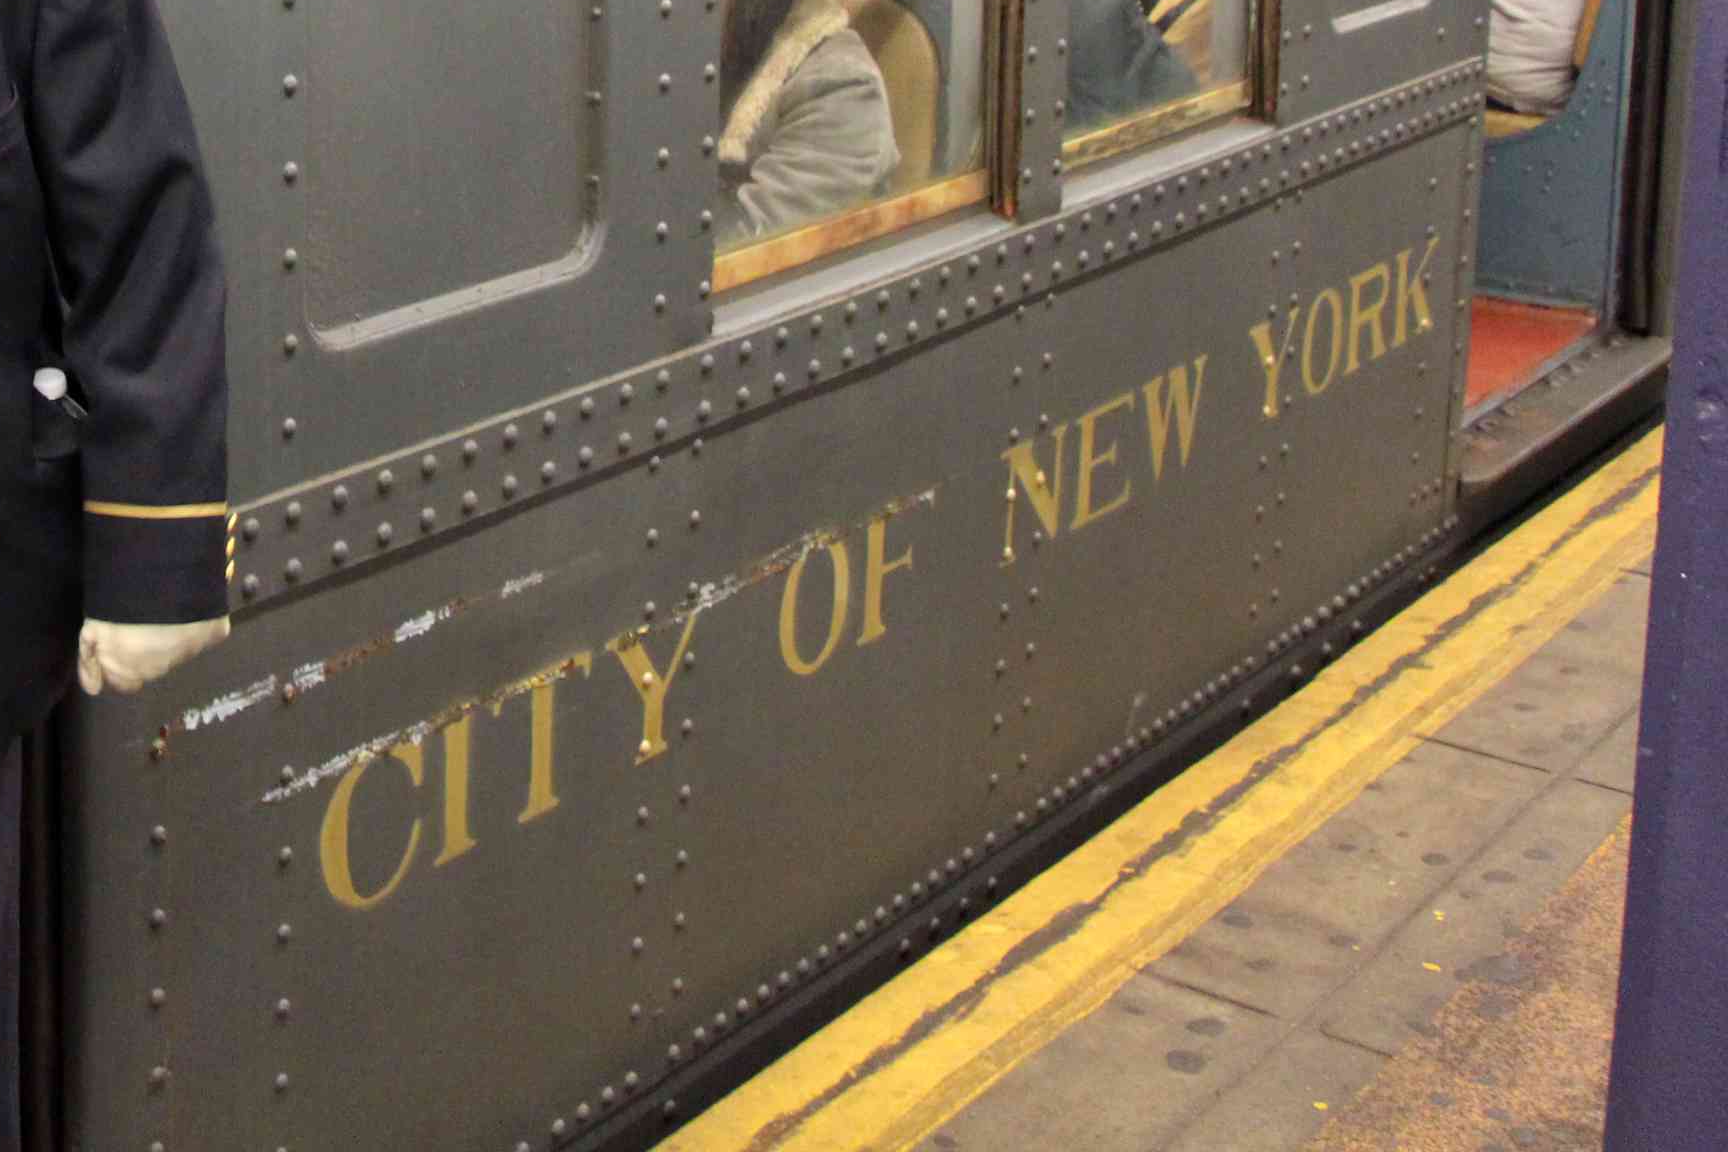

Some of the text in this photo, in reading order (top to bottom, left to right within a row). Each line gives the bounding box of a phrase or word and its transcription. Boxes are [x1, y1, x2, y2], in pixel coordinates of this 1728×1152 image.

[319, 235, 1441, 912] CITY OF NEW YORK
